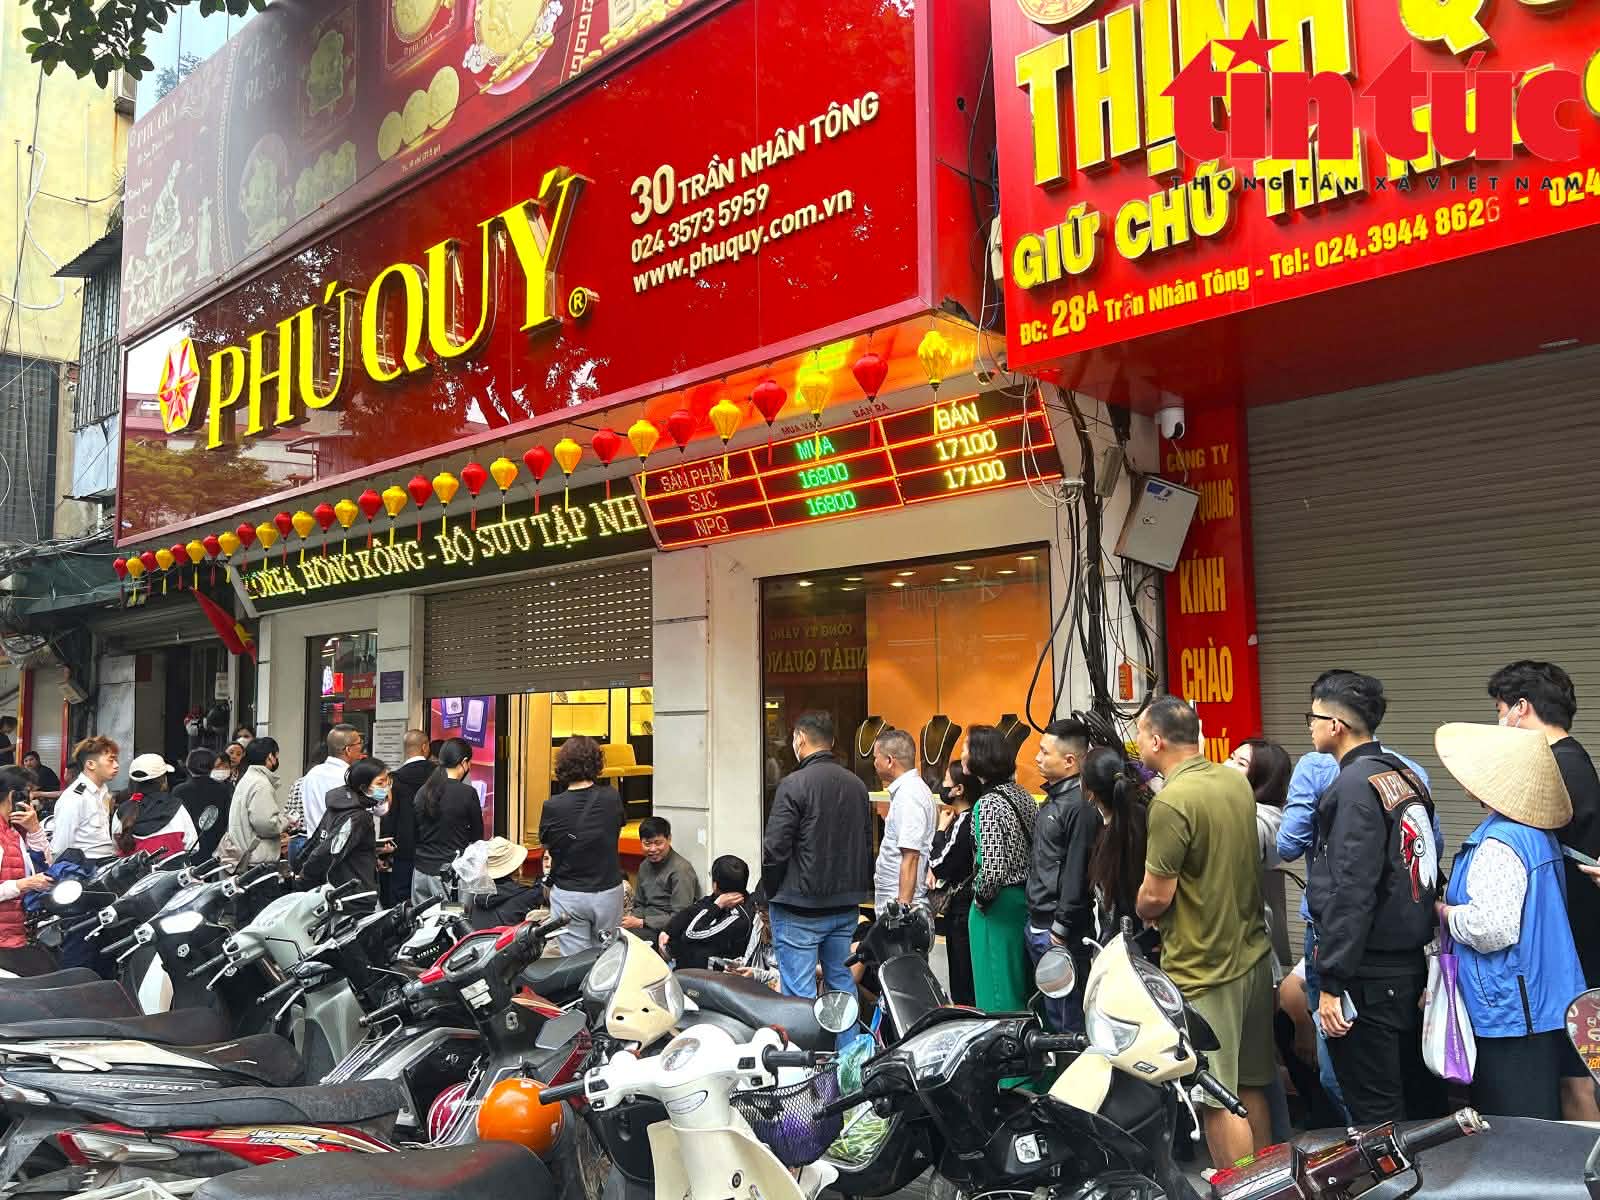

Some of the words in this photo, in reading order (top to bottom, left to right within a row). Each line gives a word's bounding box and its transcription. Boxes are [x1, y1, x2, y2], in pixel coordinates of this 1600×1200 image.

[630, 165, 676, 225] 30
[678, 154, 735, 204] TRẦN
[741, 127, 806, 178] NHÂN
[809, 91, 880, 145] TÔNG
[632, 229, 665, 263] 024
[667, 206, 715, 247] 3573
[719, 183, 770, 228] 5959
[633, 188, 854, 293] www.phuquy.com.vn
[1013, 202, 1100, 290] GIỮ
[1149, 279, 1198, 312] Nhân
[1201, 265, 1250, 297] Tông
[1269, 247, 1310, 280] Tel:
[1314, 213, 1429, 268] 024.3944
[1435, 196, 1500, 236] 8626
[207, 280, 352, 451] PHÚ
[361, 166, 588, 383] QUÝ
[936, 402, 980, 431] BÁN
[795, 437, 835, 460] MUA
[936, 429, 997, 461] 17100
[1210, 443, 1230, 465] TY
[799, 462, 849, 489] 16800
[944, 459, 1007, 489] 17100
[687, 490, 718, 512] SJC
[805, 489, 857, 516] 16800
[694, 515, 731, 537] NPQ
[434, 526, 474, 566] BỘ
[1179, 549, 1227, 614] KÍNH
[1181, 636, 1234, 703] CHÀO
